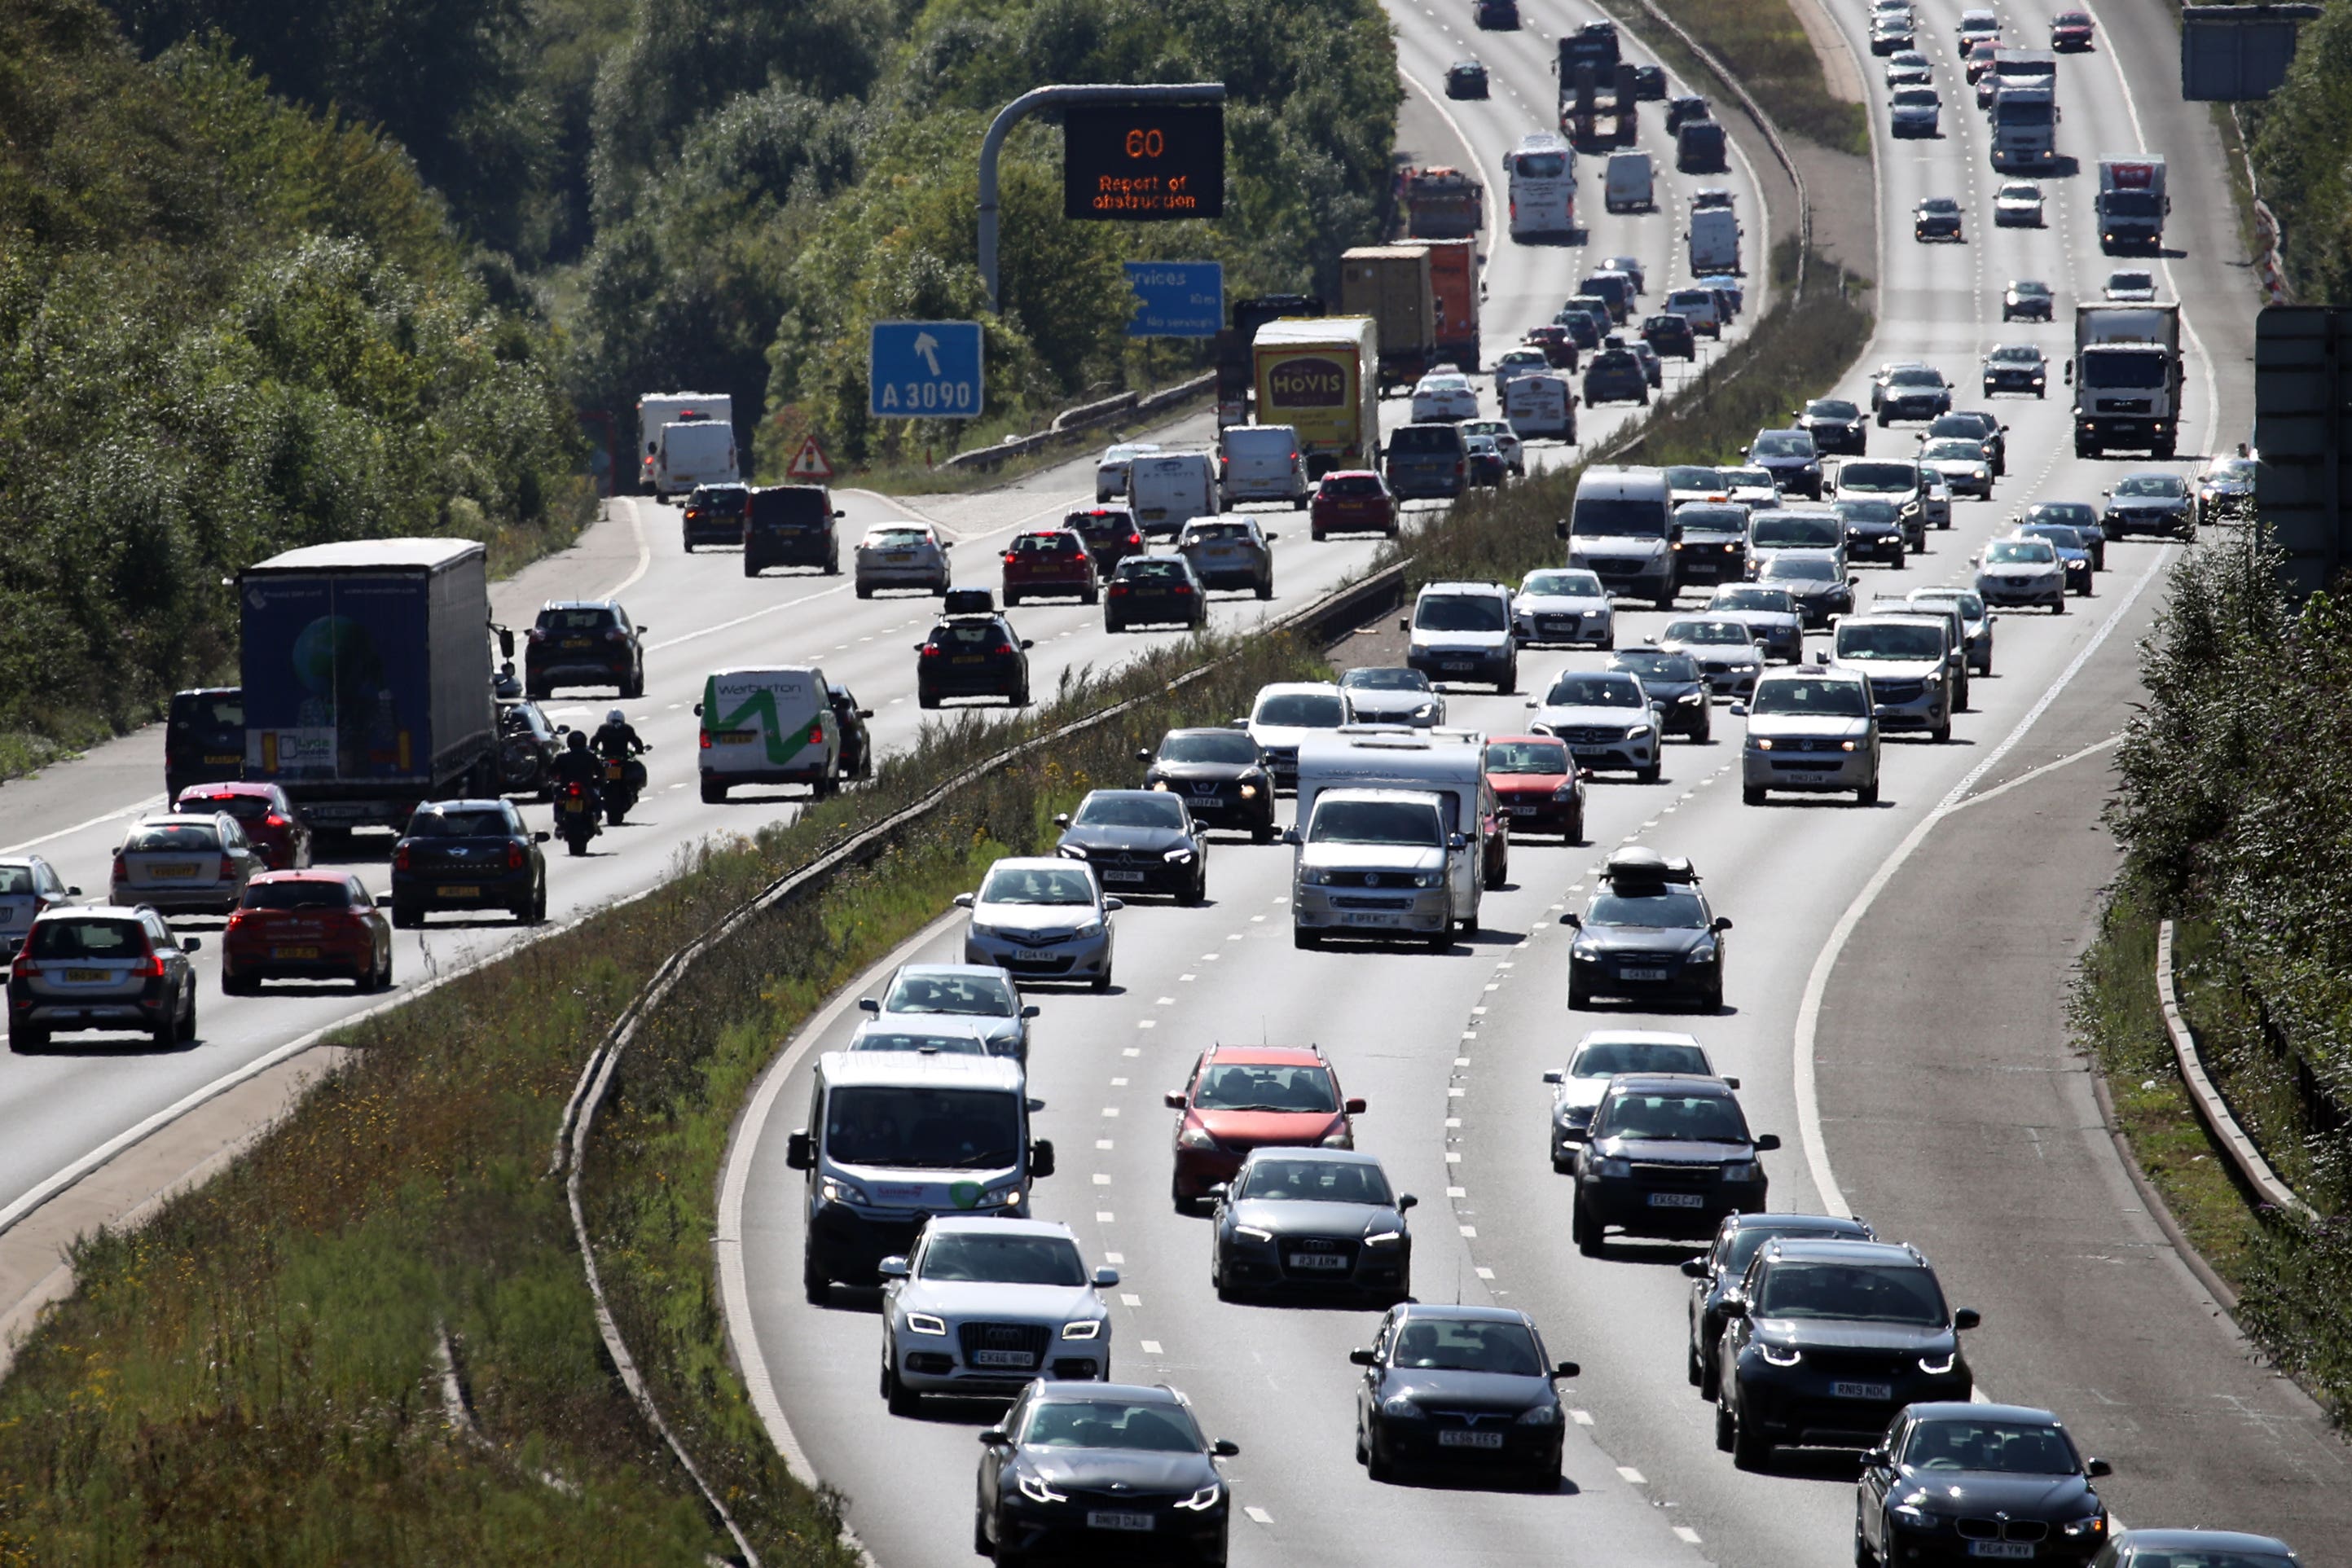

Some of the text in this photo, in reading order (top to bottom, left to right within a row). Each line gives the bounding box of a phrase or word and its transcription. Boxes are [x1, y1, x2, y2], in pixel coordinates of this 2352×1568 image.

[1125, 128, 1163, 159] 60
[1099, 174, 1187, 194] Report of
[1092, 192, 1196, 209] obstruction
[1273, 375, 1342, 393] HOVIS
[718, 683, 802, 695] Warburton
[1837, 1383, 1864, 1396] RN19
